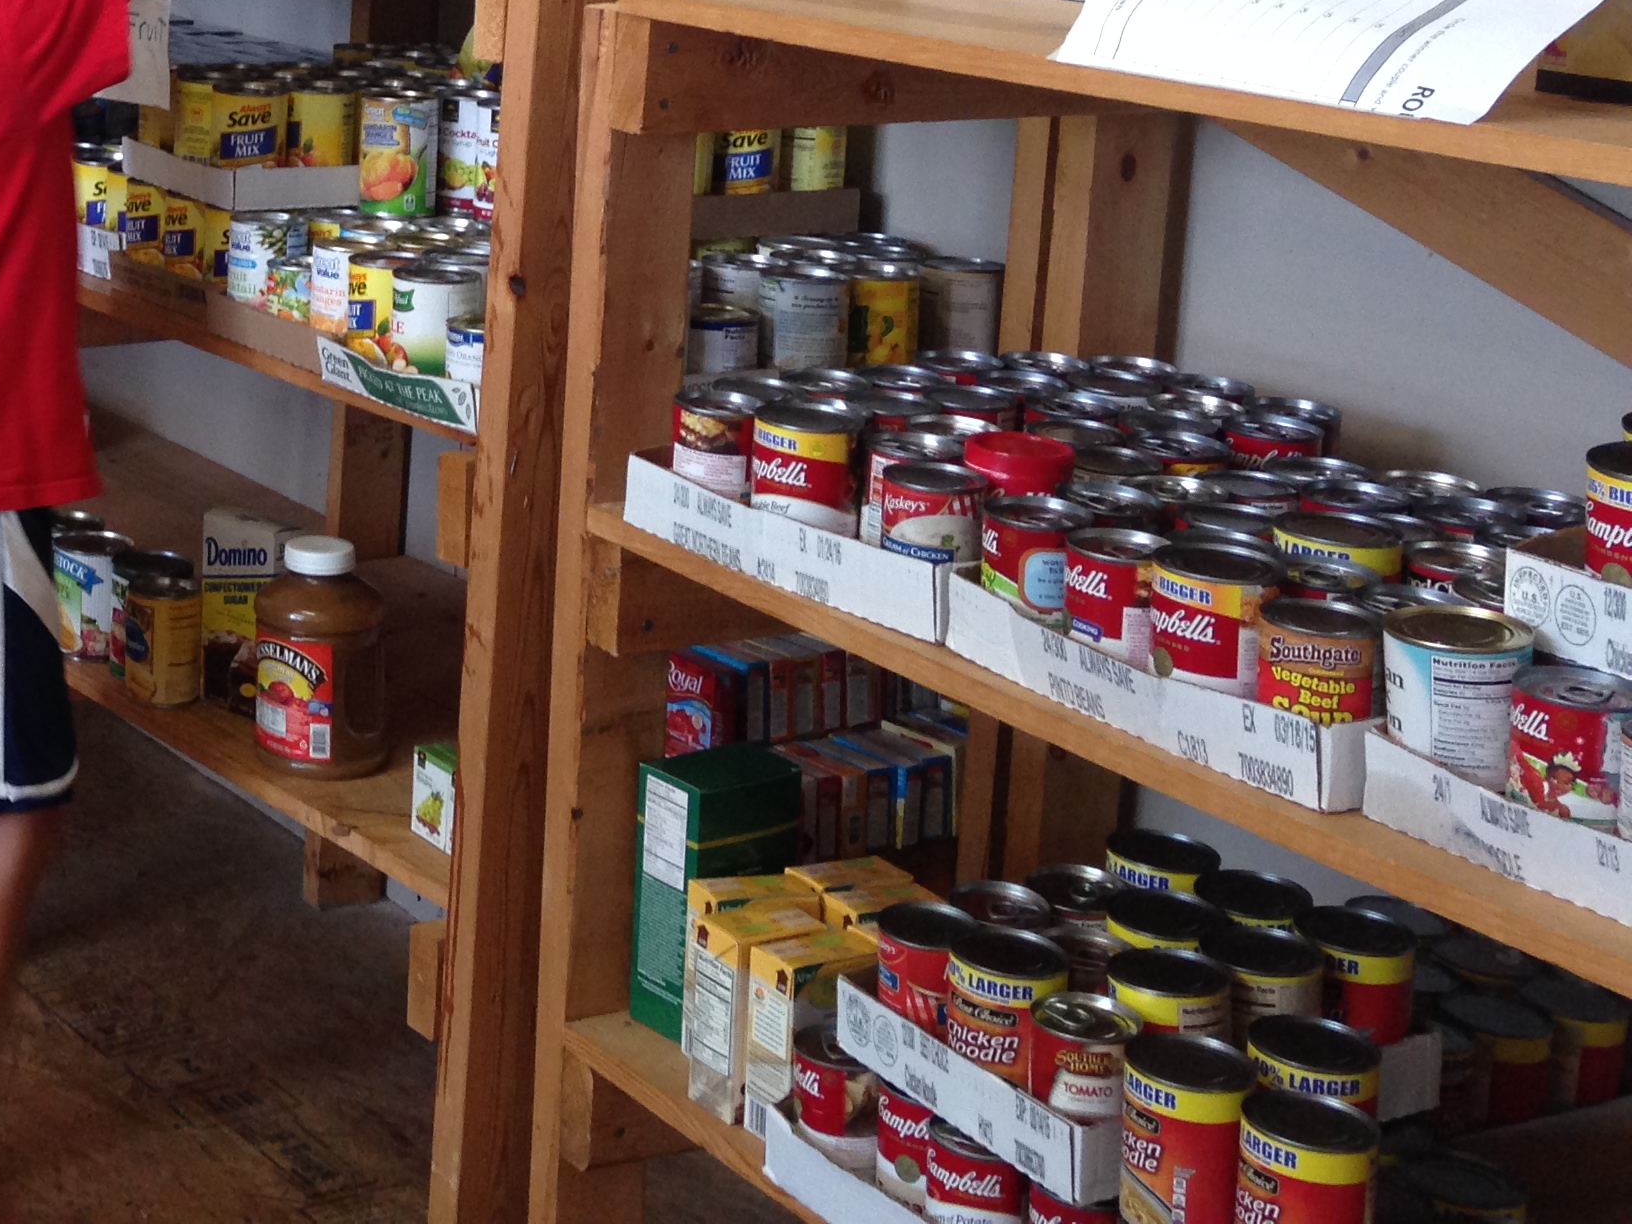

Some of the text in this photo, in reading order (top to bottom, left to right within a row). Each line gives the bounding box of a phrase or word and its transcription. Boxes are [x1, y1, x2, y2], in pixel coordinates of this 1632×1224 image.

[226, 109, 272, 128] Save
[230, 132, 266, 147] FRUIT
[234, 144, 261, 157] MIX
[720, 130, 768, 151] Save
[321, 346, 349, 370] Green
[325, 362, 352, 383] Giant
[385, 380, 396, 393] AT
[398, 382, 415, 400] THE
[416, 384, 443, 405] PEAK
[756, 429, 798, 452] BIGGER
[770, 501, 791, 514] Beef
[206, 536, 267, 567] Domino
[910, 546, 949, 562] CHICKEN
[224, 594, 248, 605] SUGAR
[1157, 577, 1212, 606] BIGGER
[1270, 635, 1361, 666] Southgate
[1433, 657, 1487, 669] Nutrition
[1271, 666, 1356, 695] Vegetable
[1298, 688, 1340, 710] Beef
[1242, 703, 1256, 734] EX
[969, 973, 1033, 1001] LARGER
[947, 1018, 1018, 1048] Chicken
[949, 1035, 1016, 1064] Noodle
[1063, 1083, 1113, 1098] TOMATO
[1289, 1073, 1360, 1095] LARGER
